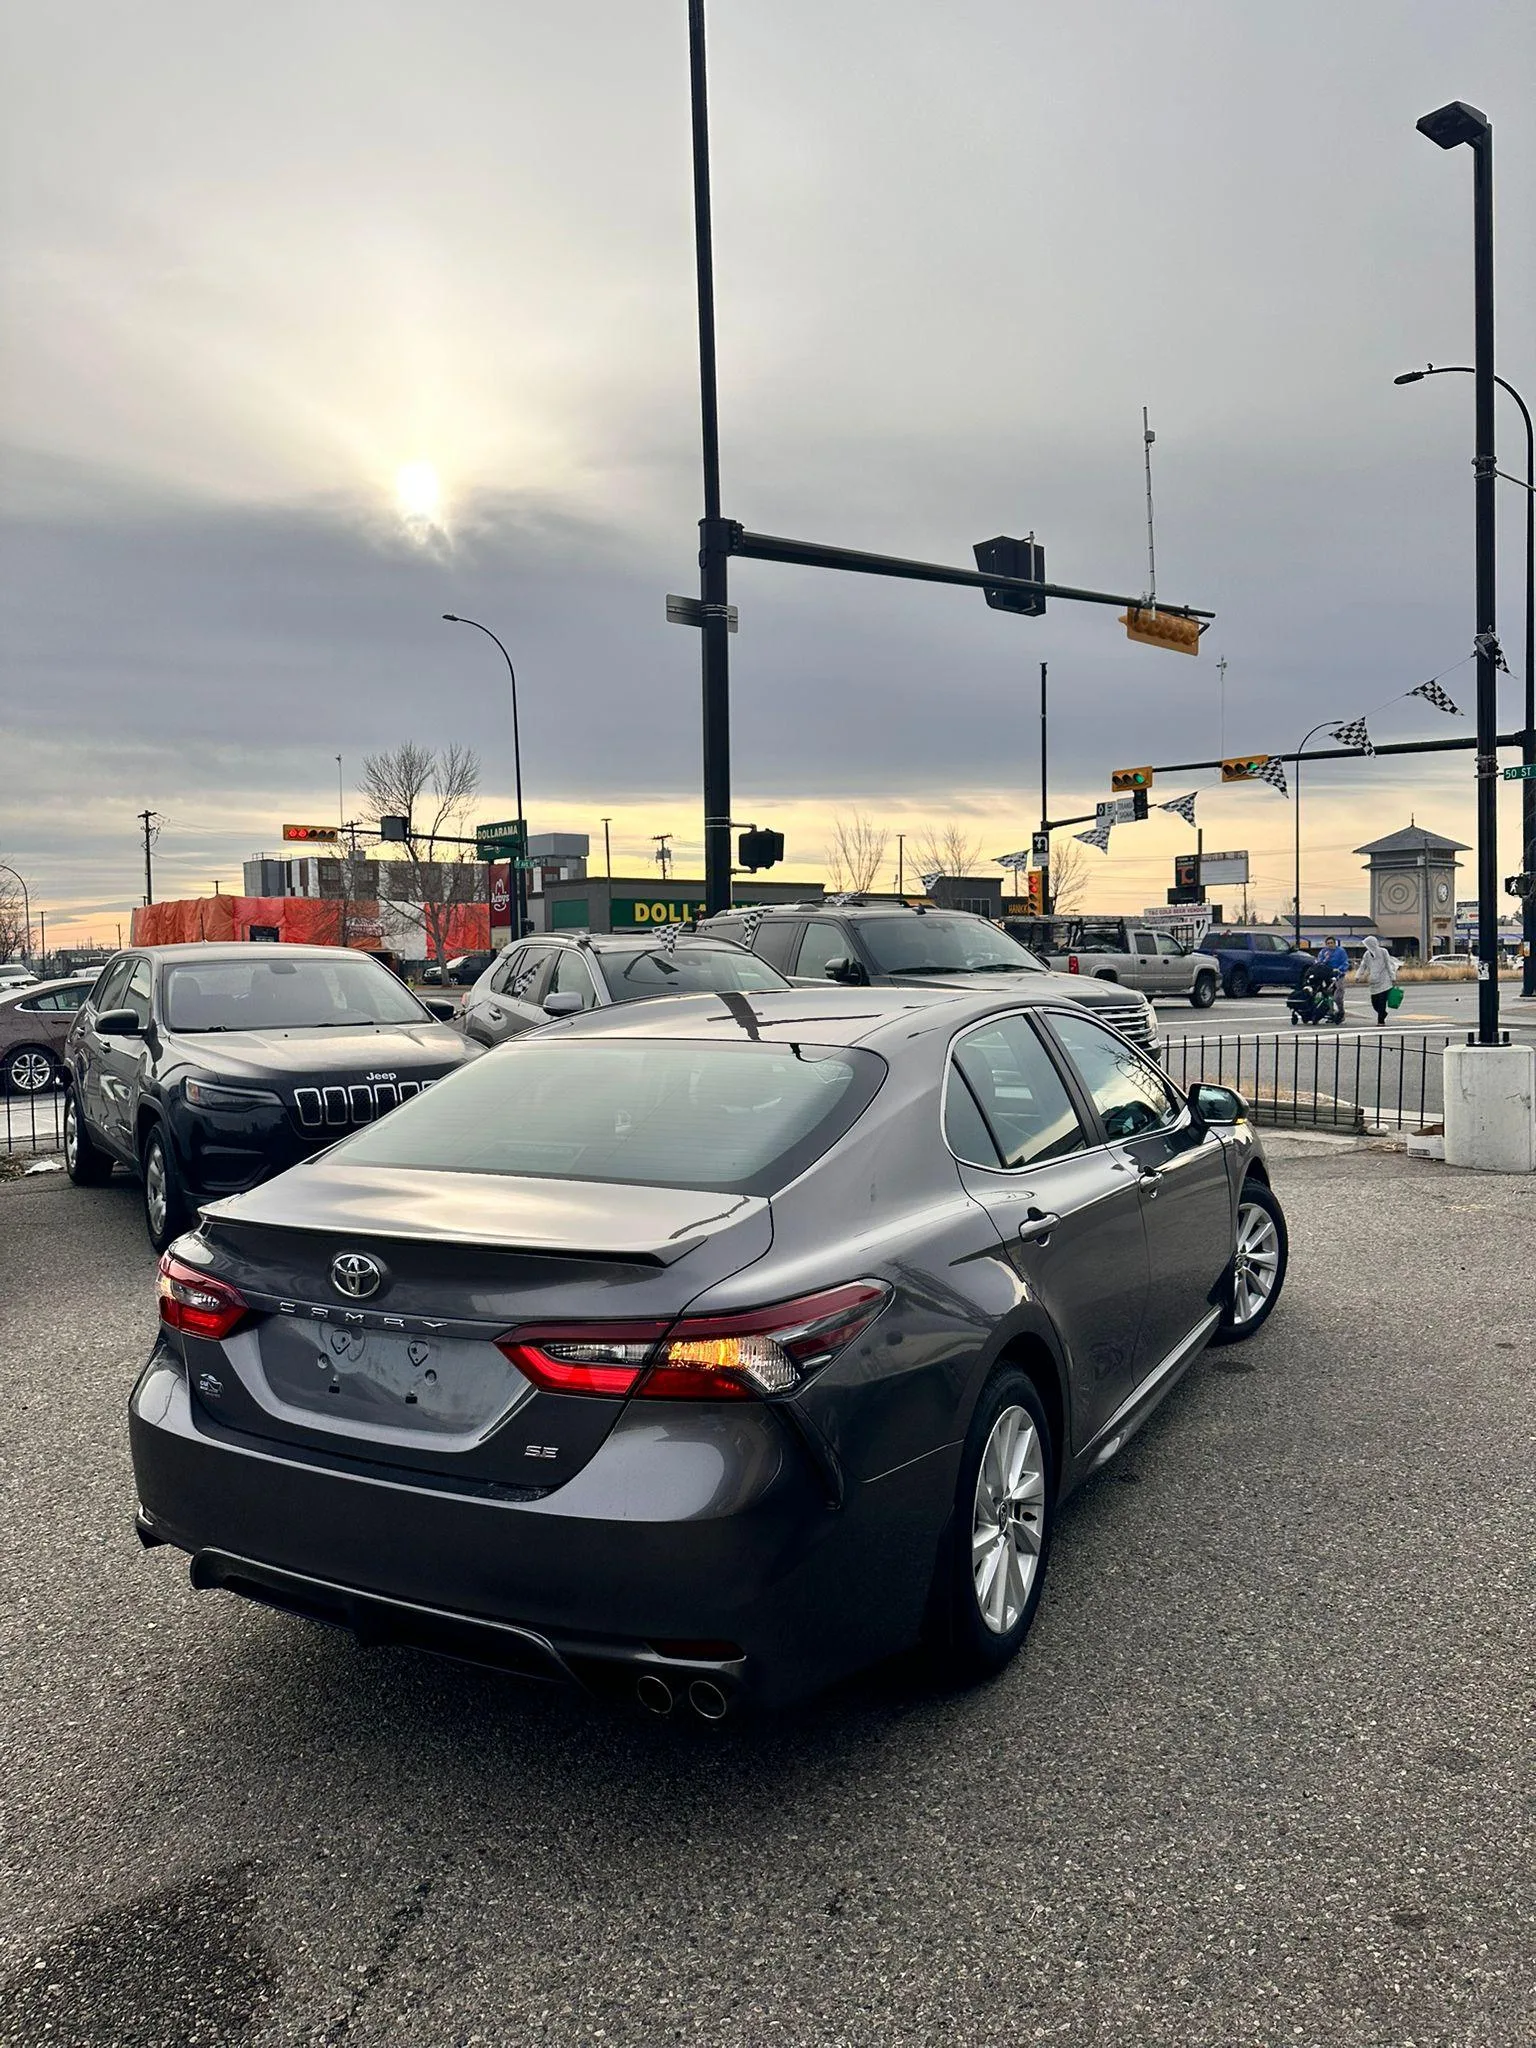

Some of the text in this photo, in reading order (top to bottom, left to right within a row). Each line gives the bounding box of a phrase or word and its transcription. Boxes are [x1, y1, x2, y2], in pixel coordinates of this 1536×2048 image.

[1505, 766, 1531, 779] 50 ST
[477, 825, 518, 840] DOLLARAMA
[491, 891, 510, 906] Arby's
[366, 1072, 397, 1081] Jeep
[279, 1301, 448, 1331] CAMRY
[524, 1445, 559, 1458] SE
